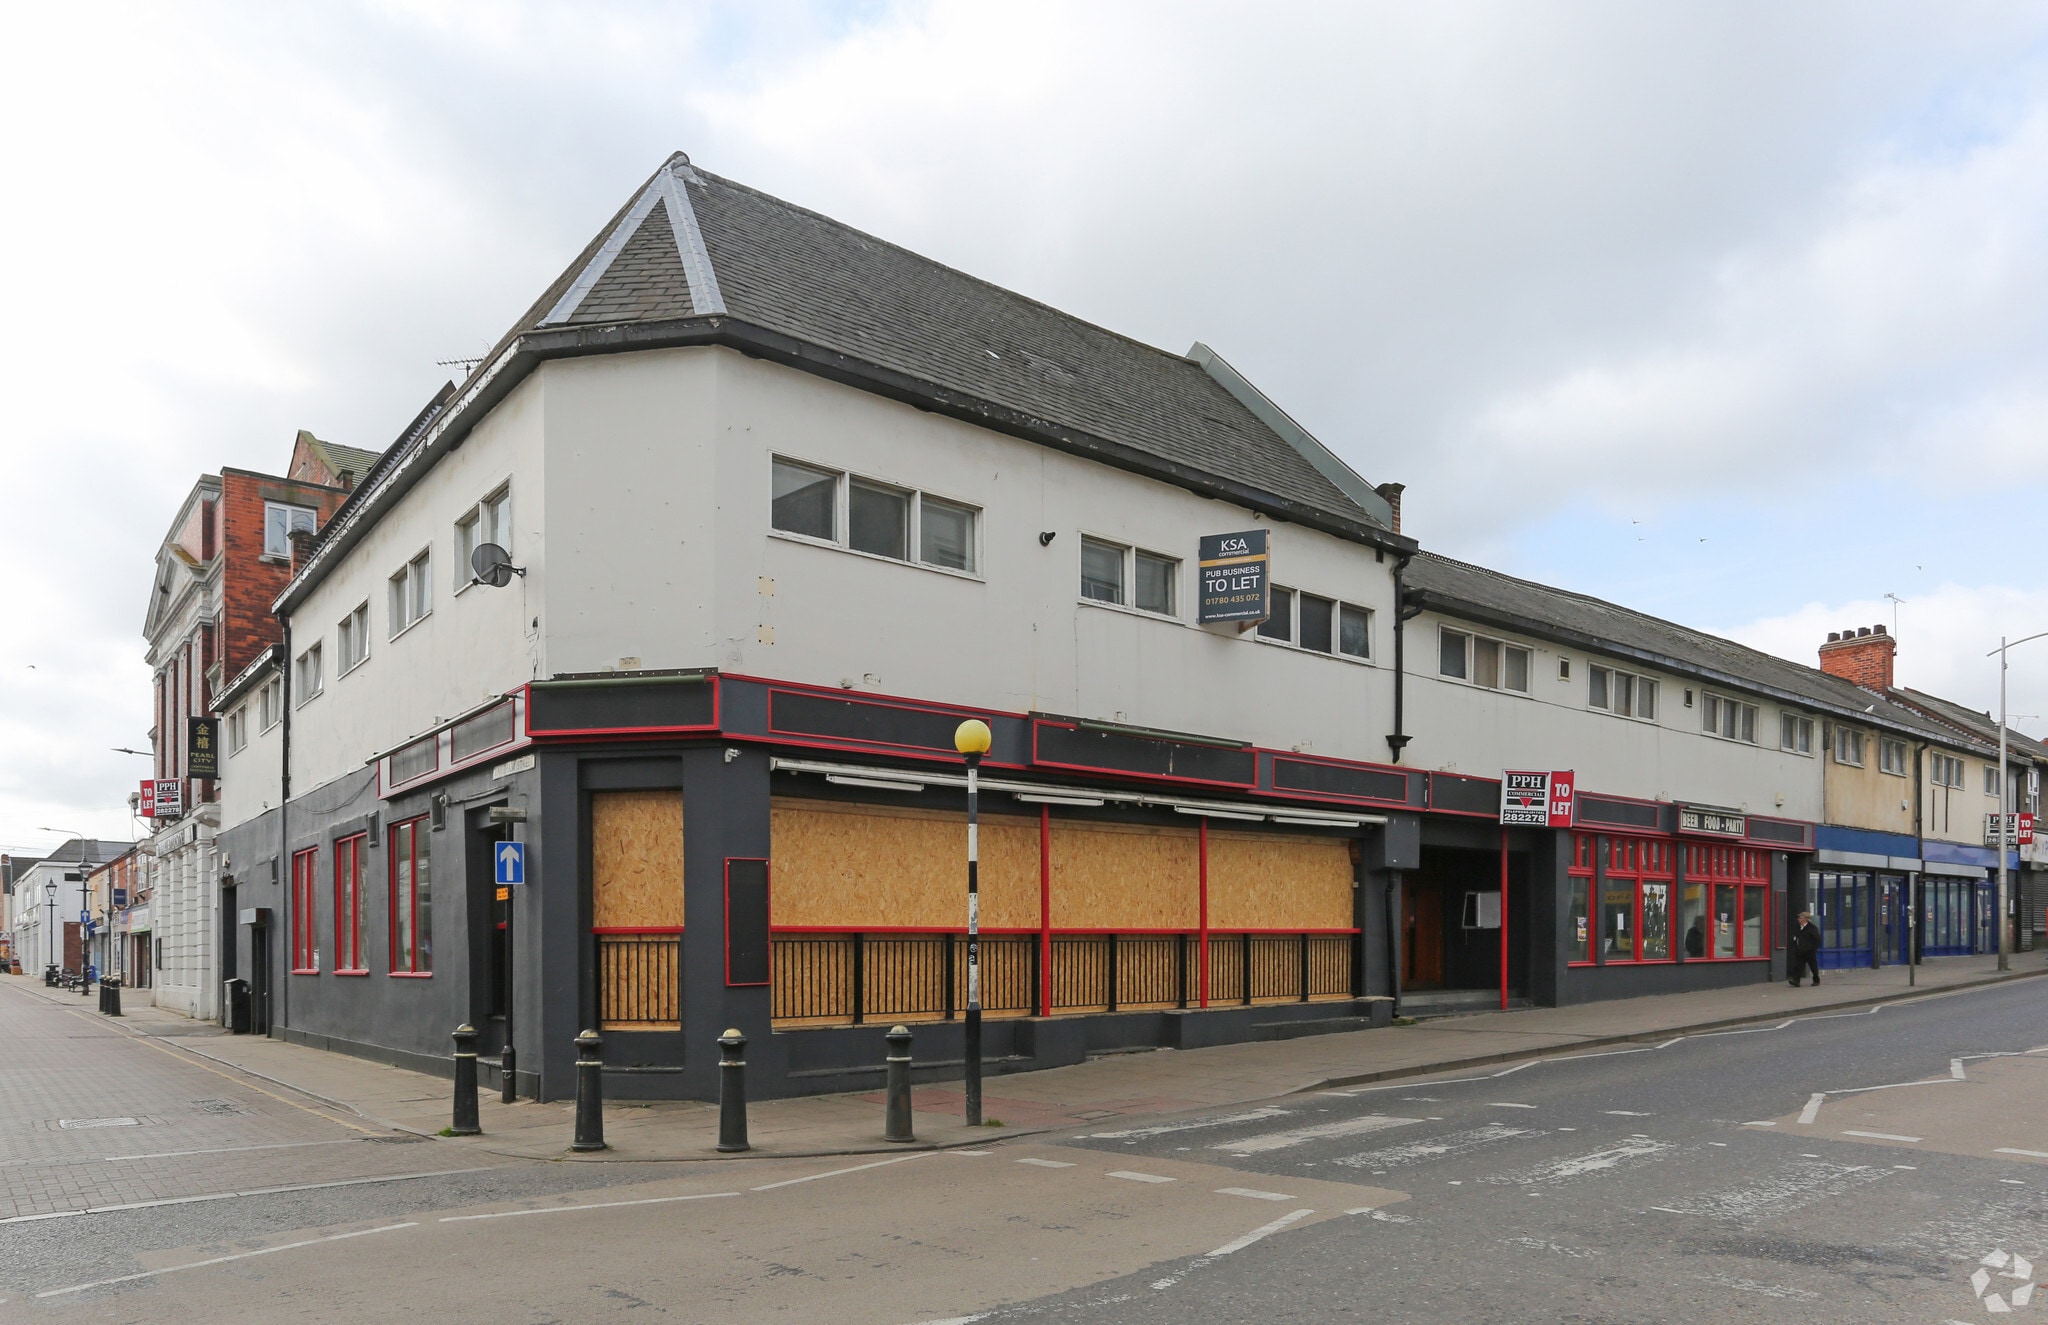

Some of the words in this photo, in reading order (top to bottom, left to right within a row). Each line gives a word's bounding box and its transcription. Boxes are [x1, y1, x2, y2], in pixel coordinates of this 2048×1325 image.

[1221, 538, 1247, 552] KSA
[1219, 548, 1250, 557] commercial
[1206, 570, 1221, 578] PUB
[1223, 566, 1260, 576] BUSINESS
[1206, 579, 1227, 592] TO
[1232, 576, 1260, 591] LET
[1205, 597, 1229, 605] 01780
[1231, 595, 1244, 603] 435
[1246, 593, 1260, 601] 072
[159, 782, 176, 791] PPH
[1511, 775, 1542, 788] PPH
[143, 788, 152, 797] TO
[1555, 783, 1570, 797] TO
[143, 799, 153, 809] LET
[1551, 801, 1571, 815] LET
[1504, 814, 1545, 822] 282278
[1683, 812, 1698, 828] BEER
[1704, 815, 1720, 830] FOOD
[1725, 818, 1743, 833] PARTY
[2021, 819, 2031, 828] TO
[2019, 830, 2031, 838] LET
